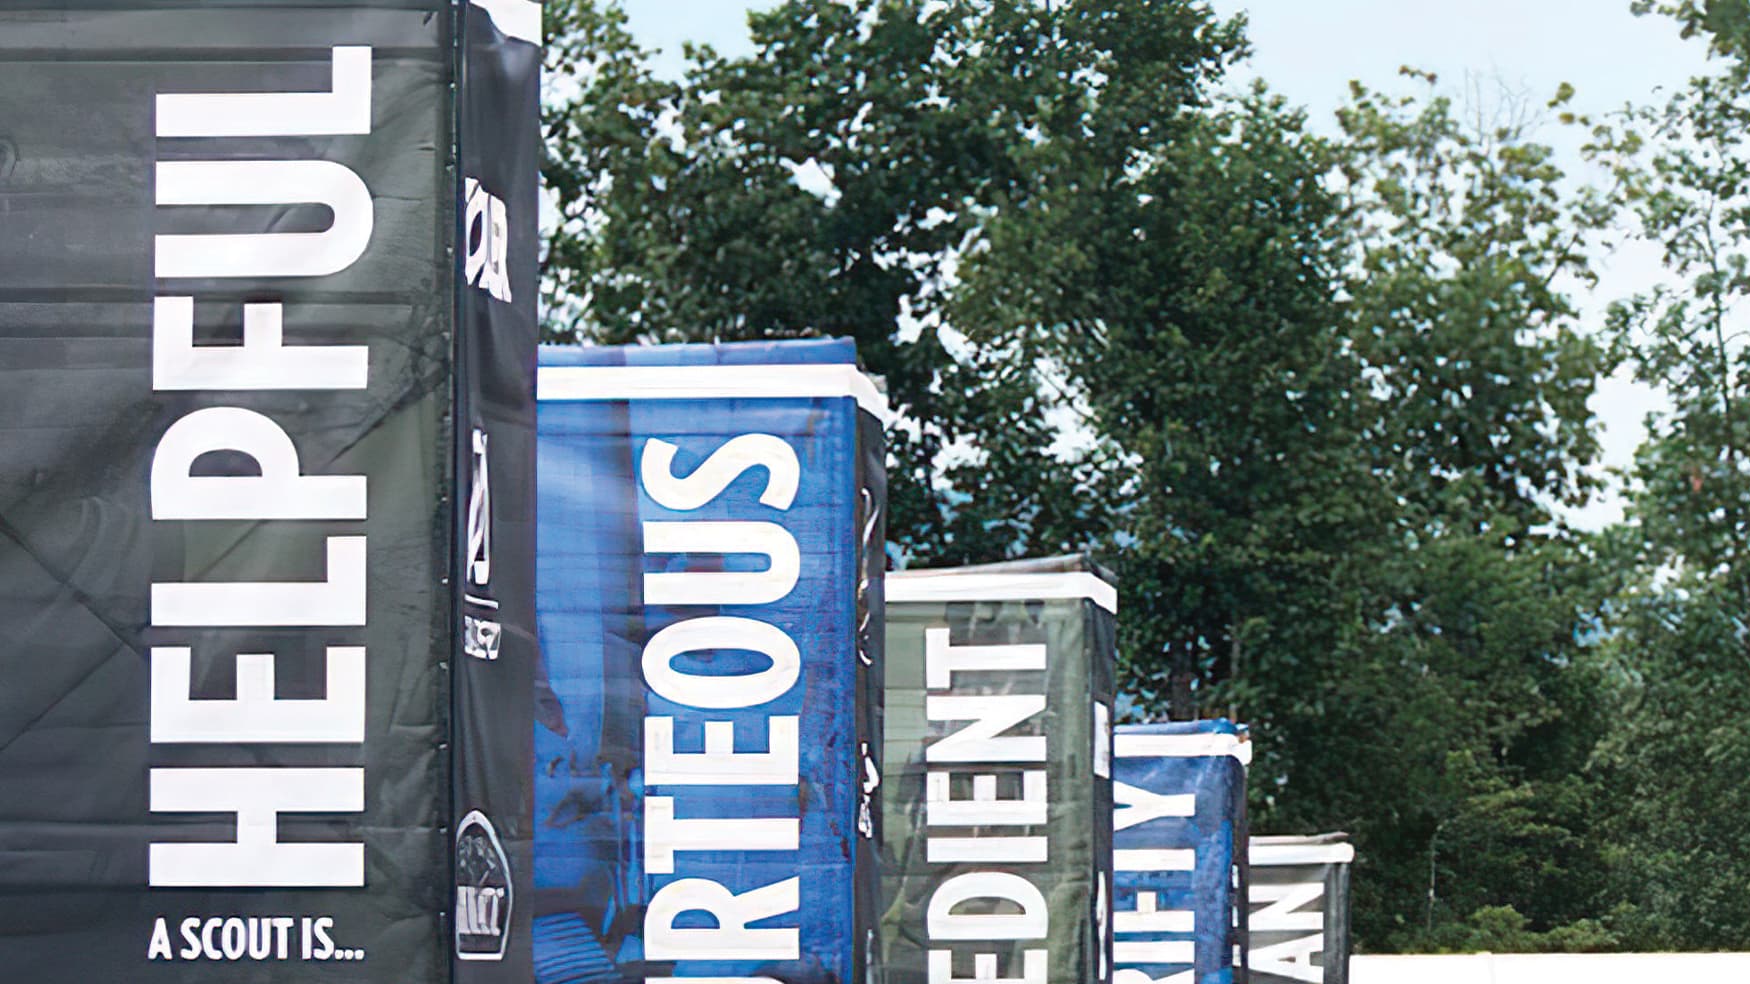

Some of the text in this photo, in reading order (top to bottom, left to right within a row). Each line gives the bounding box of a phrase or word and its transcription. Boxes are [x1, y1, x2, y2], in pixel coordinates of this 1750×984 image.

[149, 46, 374, 886] HELPFUL
[148, 917, 364, 960] A SCOUT IS...
